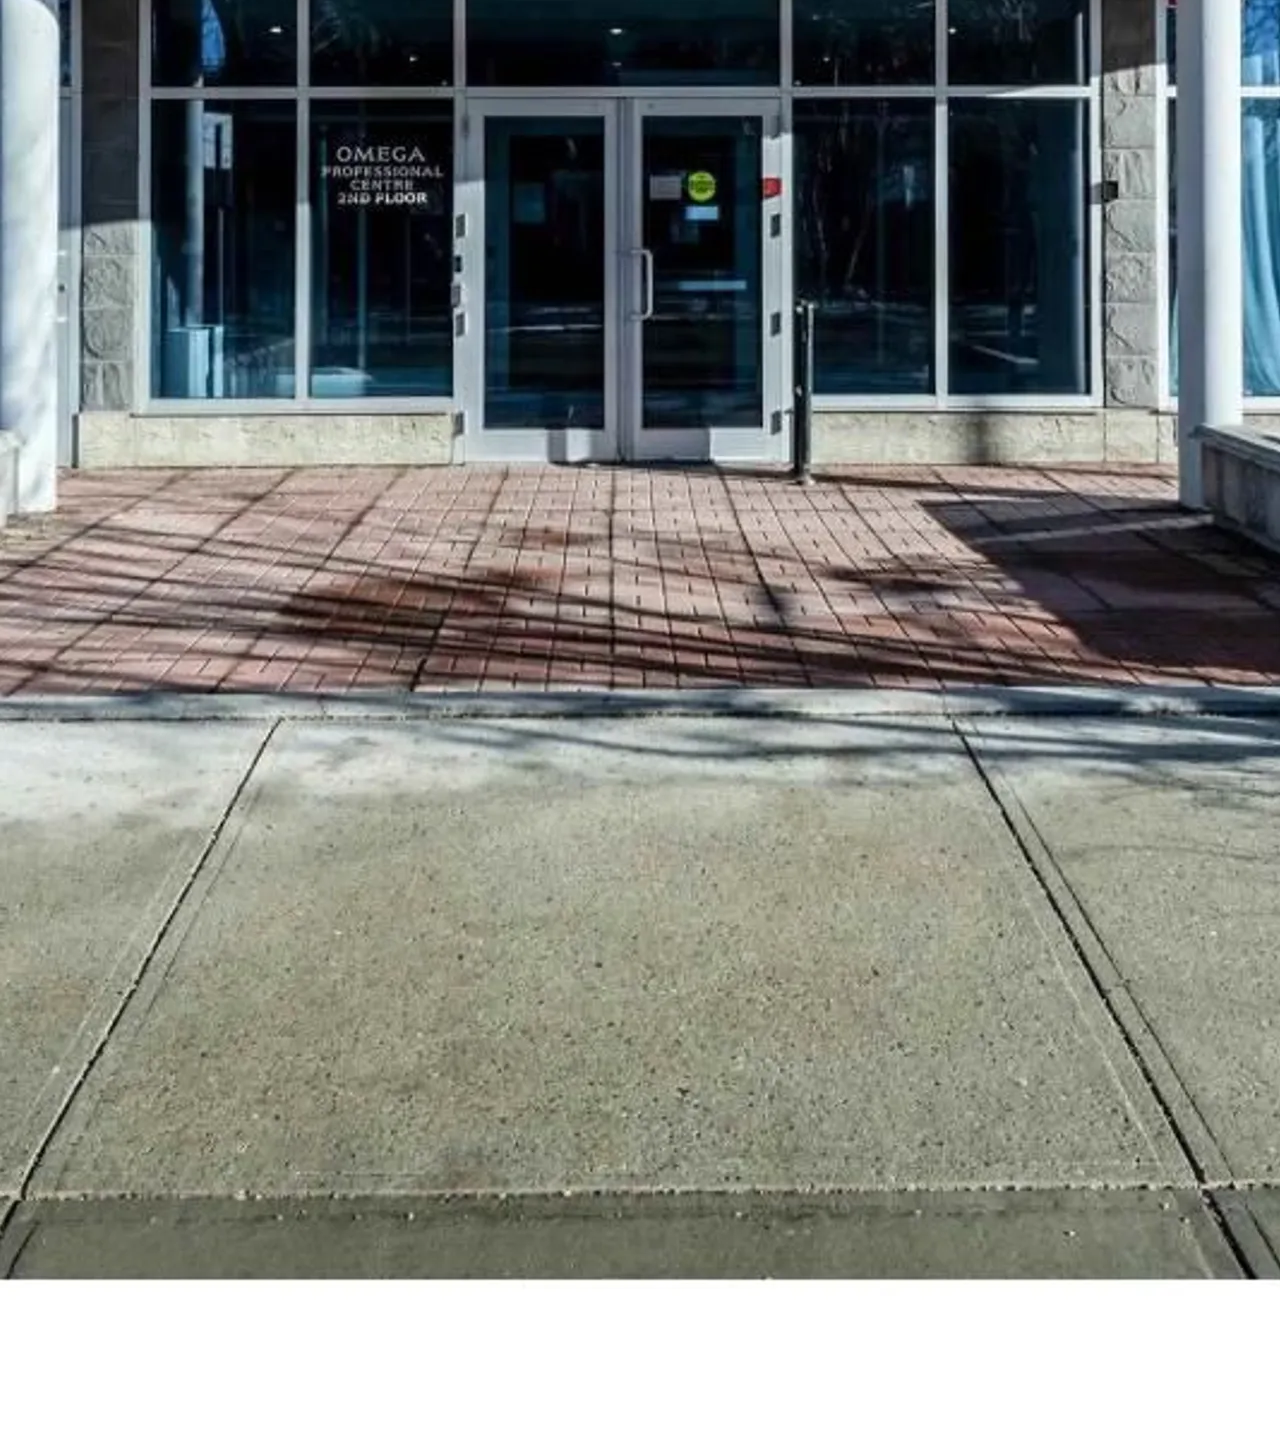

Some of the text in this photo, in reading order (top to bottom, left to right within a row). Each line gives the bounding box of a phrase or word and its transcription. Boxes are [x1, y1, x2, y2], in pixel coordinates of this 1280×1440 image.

[335, 146, 426, 162] OMEGA
[321, 165, 444, 178] PROFESSIONAL
[349, 179, 414, 192] CENTRE
[337, 192, 429, 205] 2ND FLOOR
